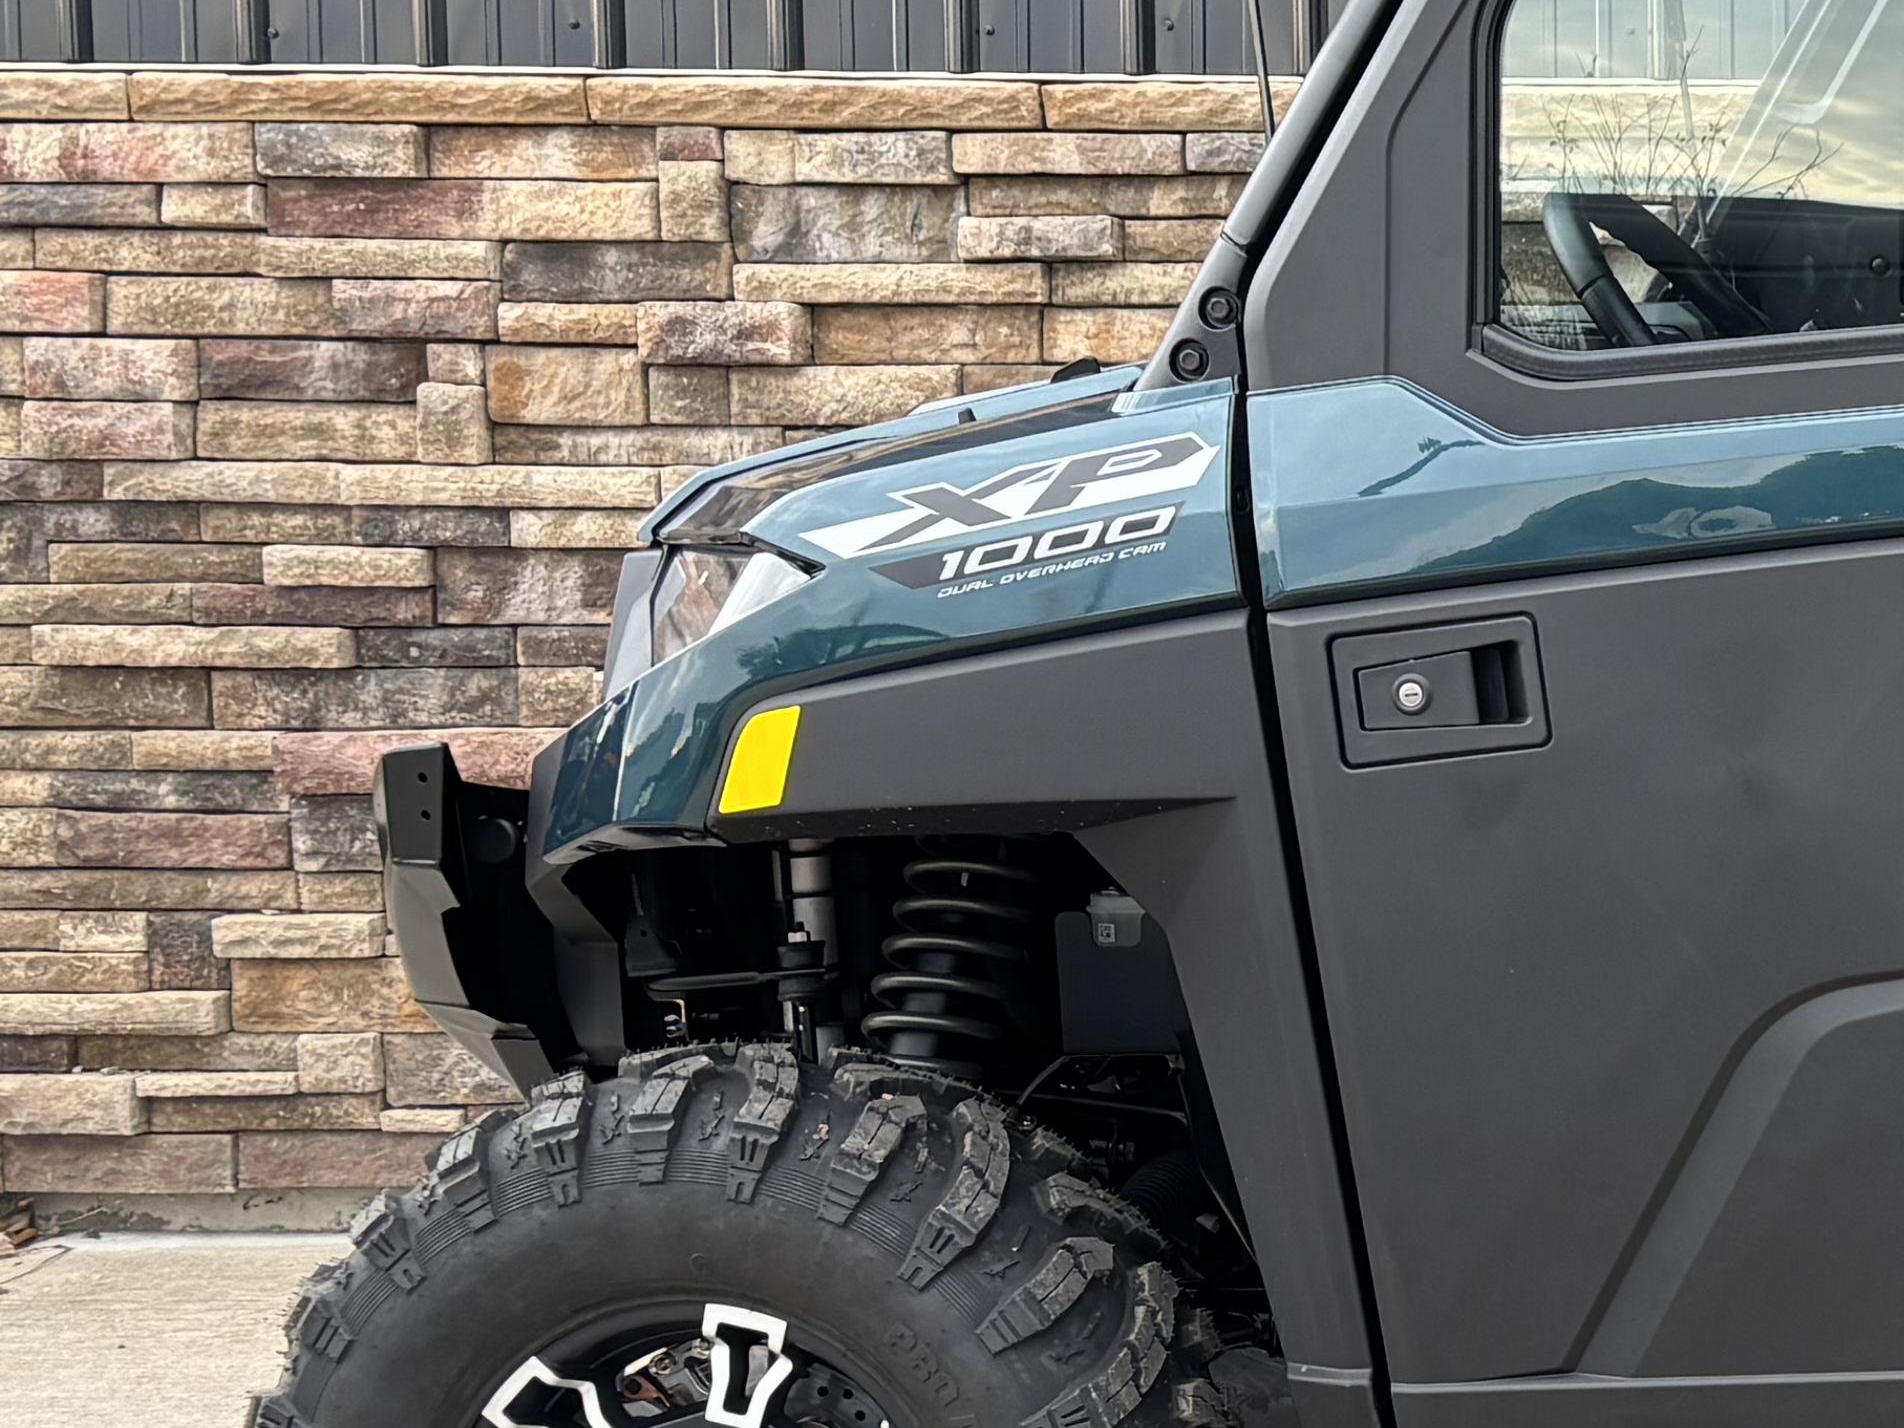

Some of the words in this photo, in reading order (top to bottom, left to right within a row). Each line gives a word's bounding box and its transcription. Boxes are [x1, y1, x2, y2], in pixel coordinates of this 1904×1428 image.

[856, 436, 1206, 553] XP
[937, 581, 994, 598] DUAL
[1000, 553, 1115, 585] OVERHEAD
[1118, 541, 1168, 560] CAM
[938, 506, 1177, 581] 1000
[882, 1324, 960, 1407] PRO
